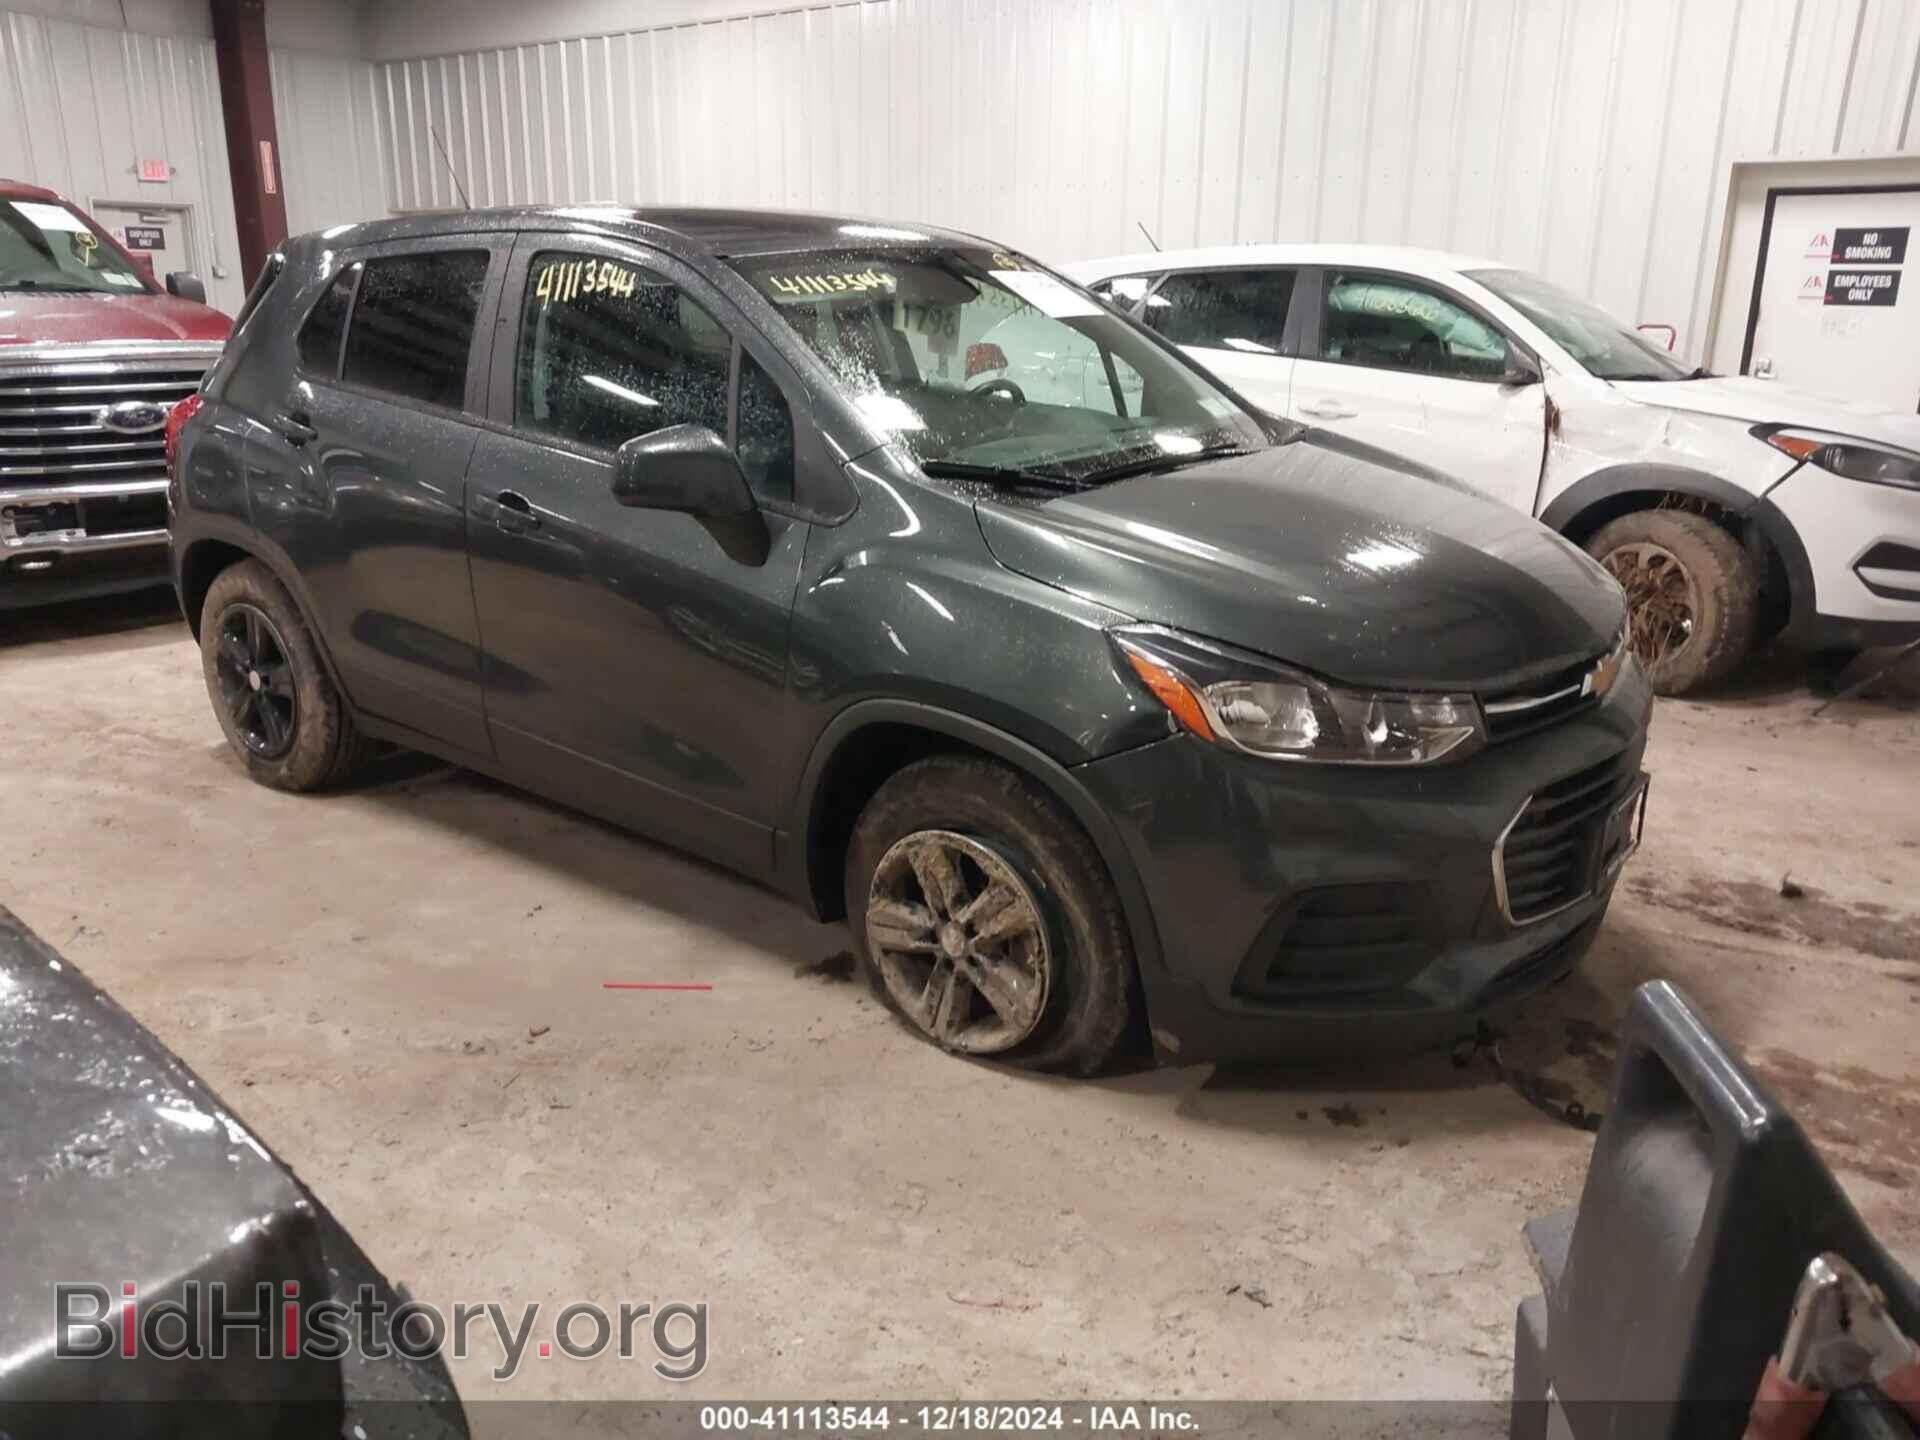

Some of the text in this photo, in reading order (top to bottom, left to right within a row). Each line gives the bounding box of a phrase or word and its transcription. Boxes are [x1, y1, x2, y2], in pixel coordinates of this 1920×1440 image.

[1862, 232, 1879, 246] NO
[1844, 246, 1892, 260] SMOKING
[536, 259, 636, 310] 41113544
[1834, 274, 1893, 288] EMPLOYEES
[1848, 288, 1874, 302] ONLY
